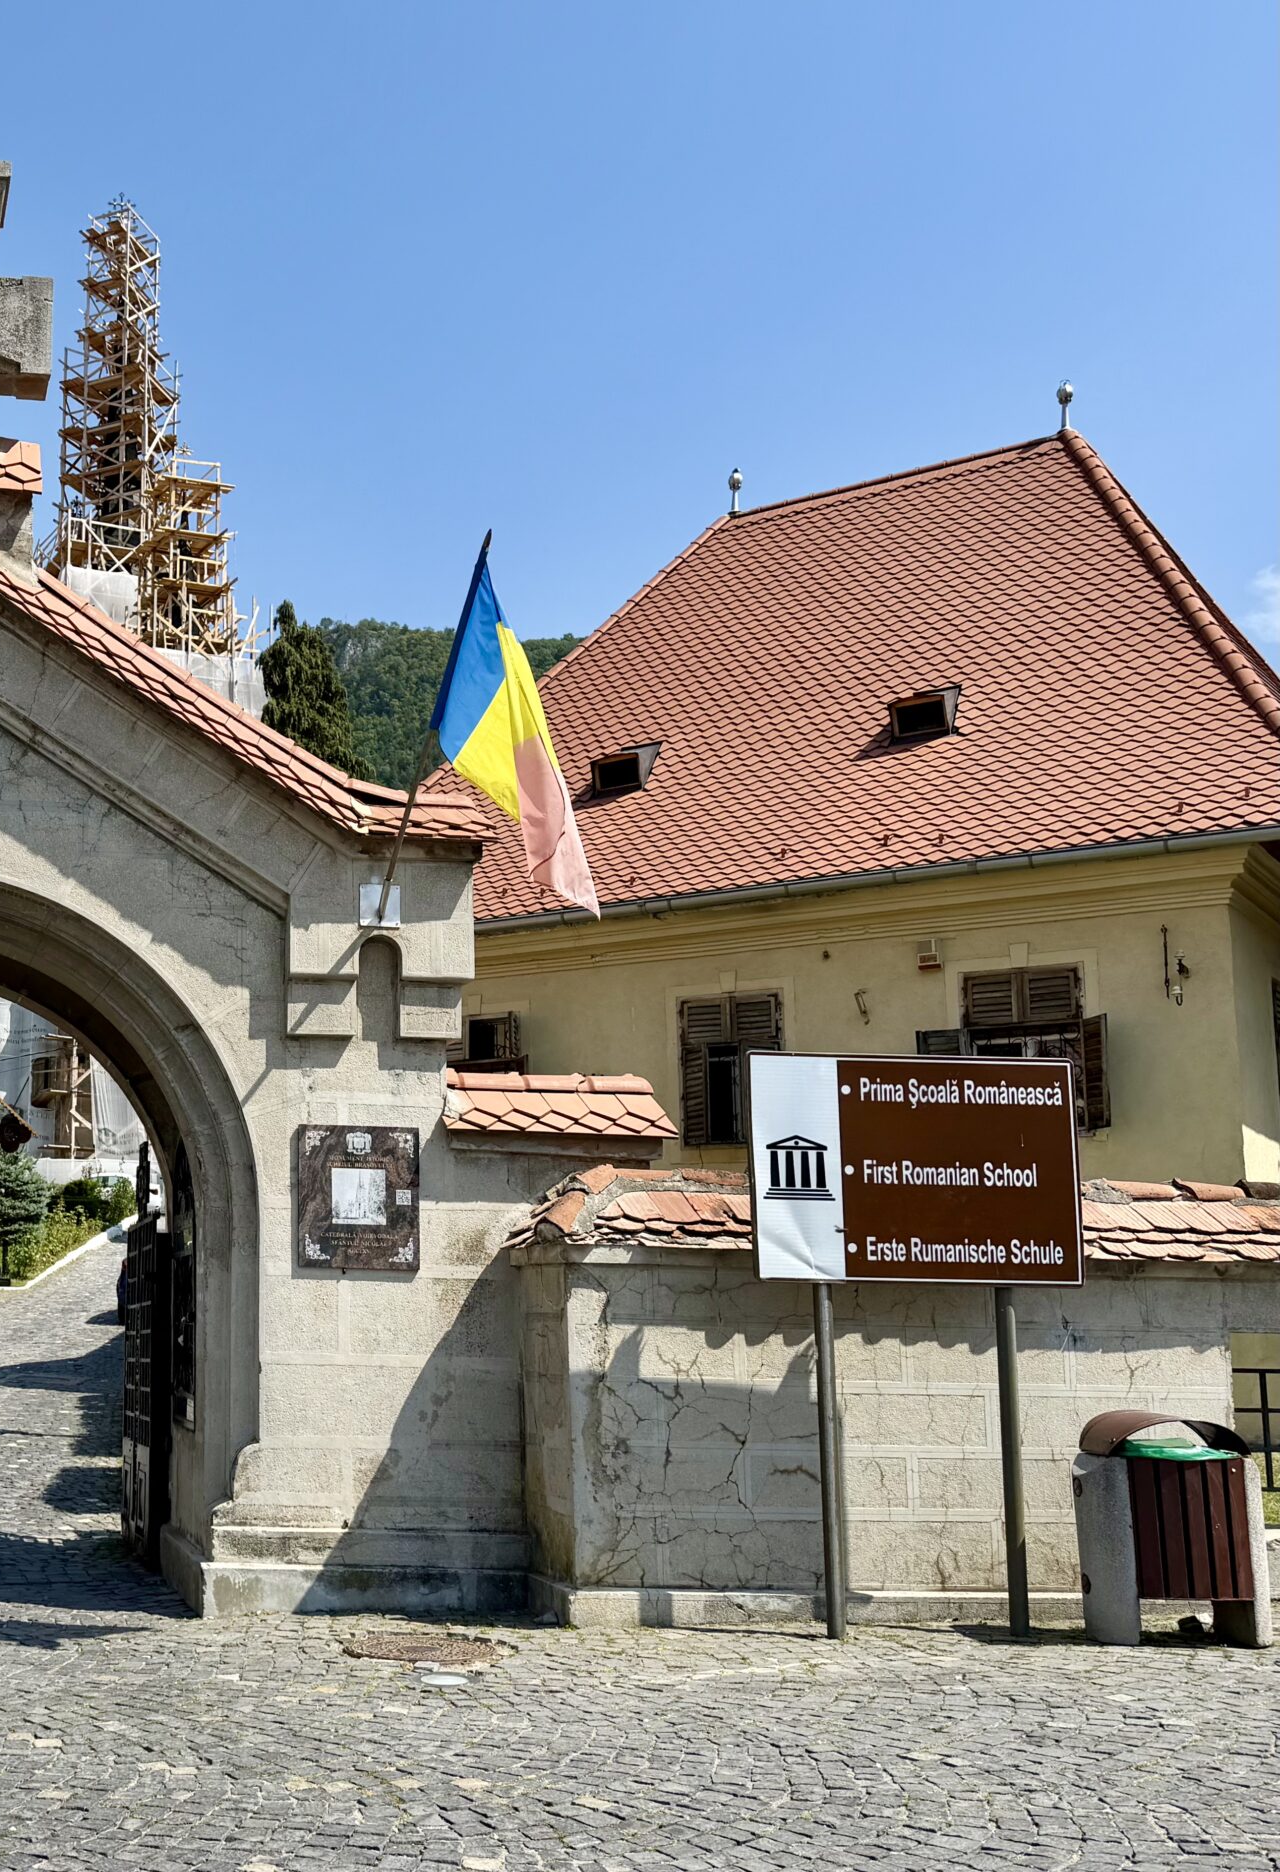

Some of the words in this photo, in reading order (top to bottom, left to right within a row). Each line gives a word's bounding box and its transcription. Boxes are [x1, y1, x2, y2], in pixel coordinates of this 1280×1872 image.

[859, 1077, 904, 1103] Prima
[963, 1079, 1063, 1106] Românească
[863, 1159, 899, 1185] First
[901, 1160, 979, 1186] Romanian
[983, 1161, 1038, 1188] School
[866, 1236, 907, 1262] Erste
[910, 1237, 1006, 1264] Rumanische
[1010, 1238, 1064, 1265] Schule
